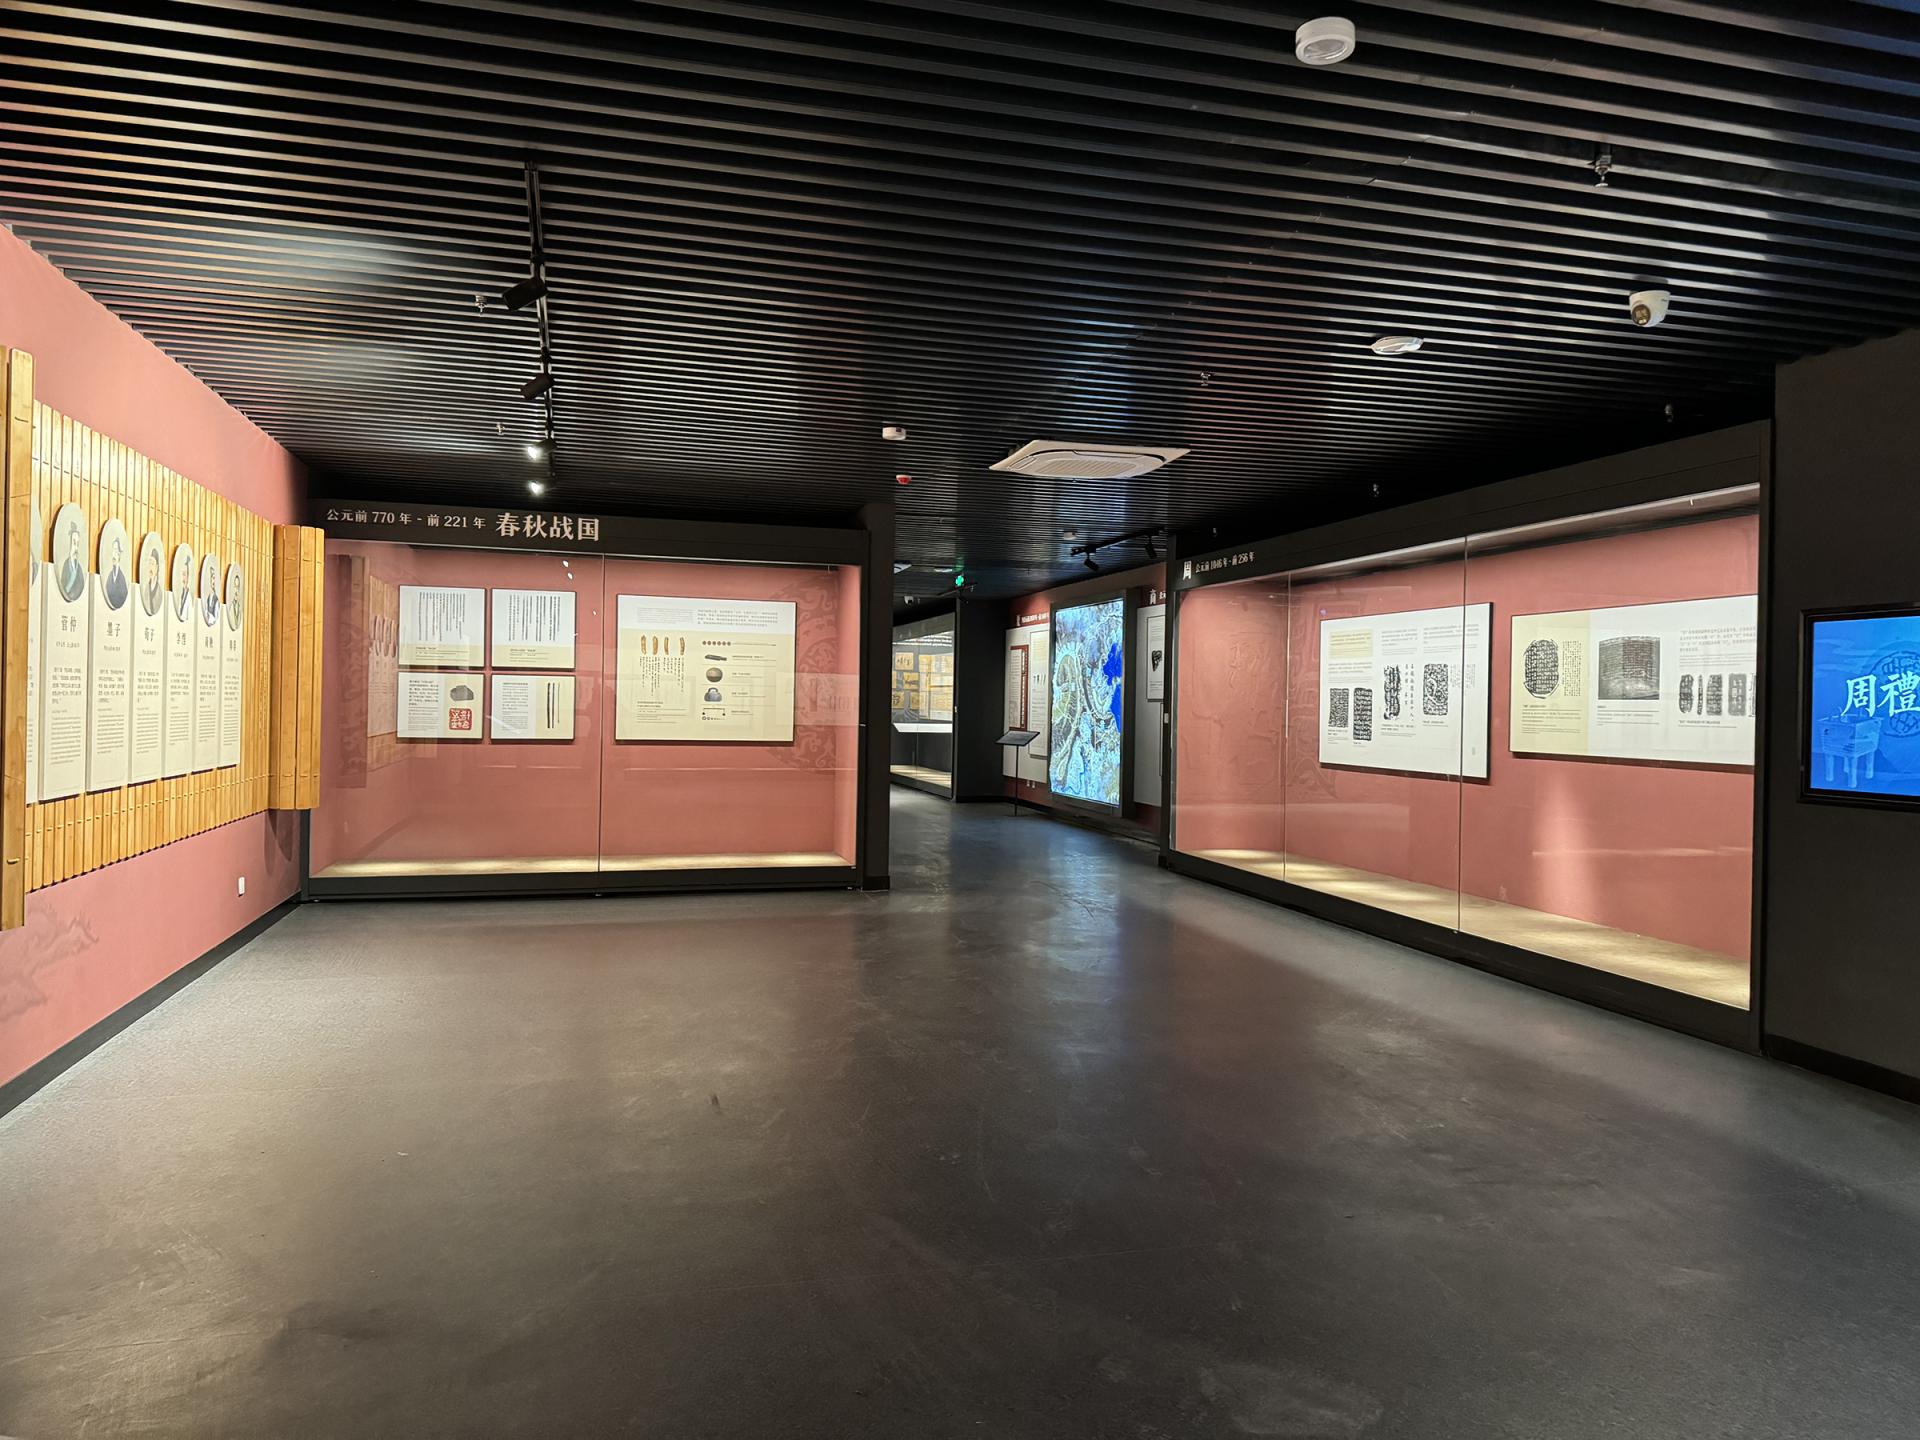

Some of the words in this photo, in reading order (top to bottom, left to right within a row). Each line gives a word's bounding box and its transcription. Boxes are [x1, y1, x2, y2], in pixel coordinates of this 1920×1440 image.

[327, 508, 368, 523] 公元前
[372, 511, 395, 524] 770
[399, 512, 412, 525] 年
[427, 514, 440, 527] 前
[443, 515, 467, 528] 221
[473, 516, 486, 529] 年
[495, 512, 600, 541] 春秋战国
[1182, 560, 1192, 580] 周
[106, 621, 121, 637] 墨子
[1840, 670, 1920, 718] 周禮
